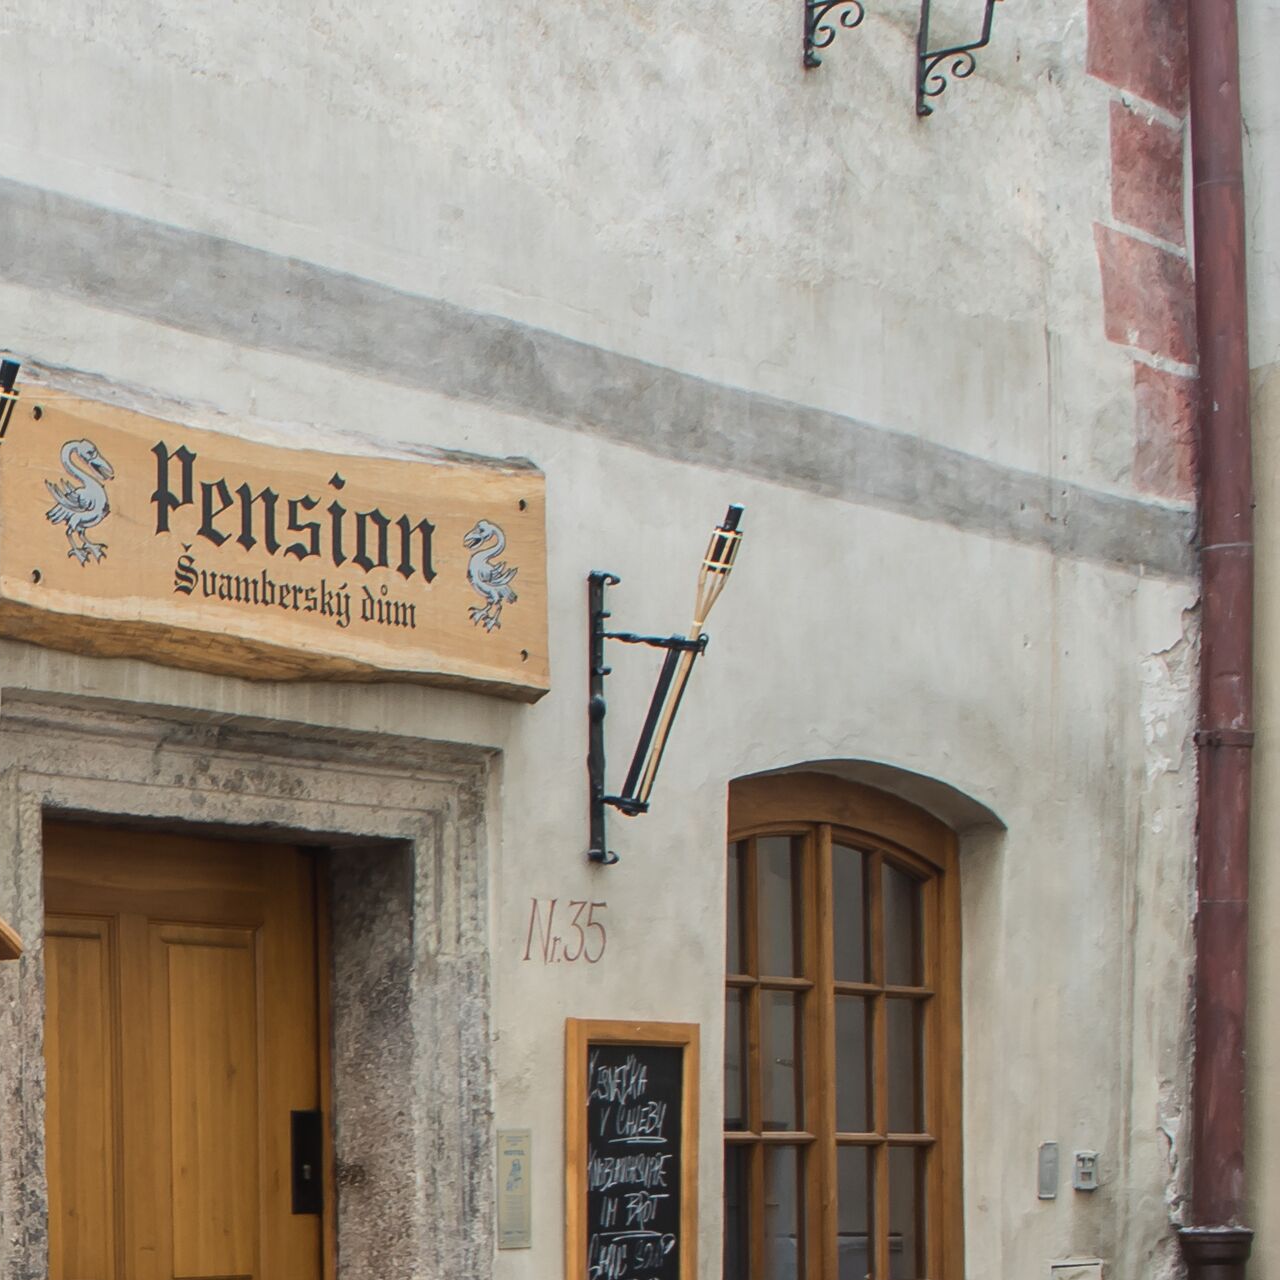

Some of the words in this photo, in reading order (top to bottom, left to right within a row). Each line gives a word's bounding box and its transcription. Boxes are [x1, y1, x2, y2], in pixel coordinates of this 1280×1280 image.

[149, 439, 438, 584] Pension
[173, 542, 352, 629] Švamberský
[360, 584, 417, 629] dům
